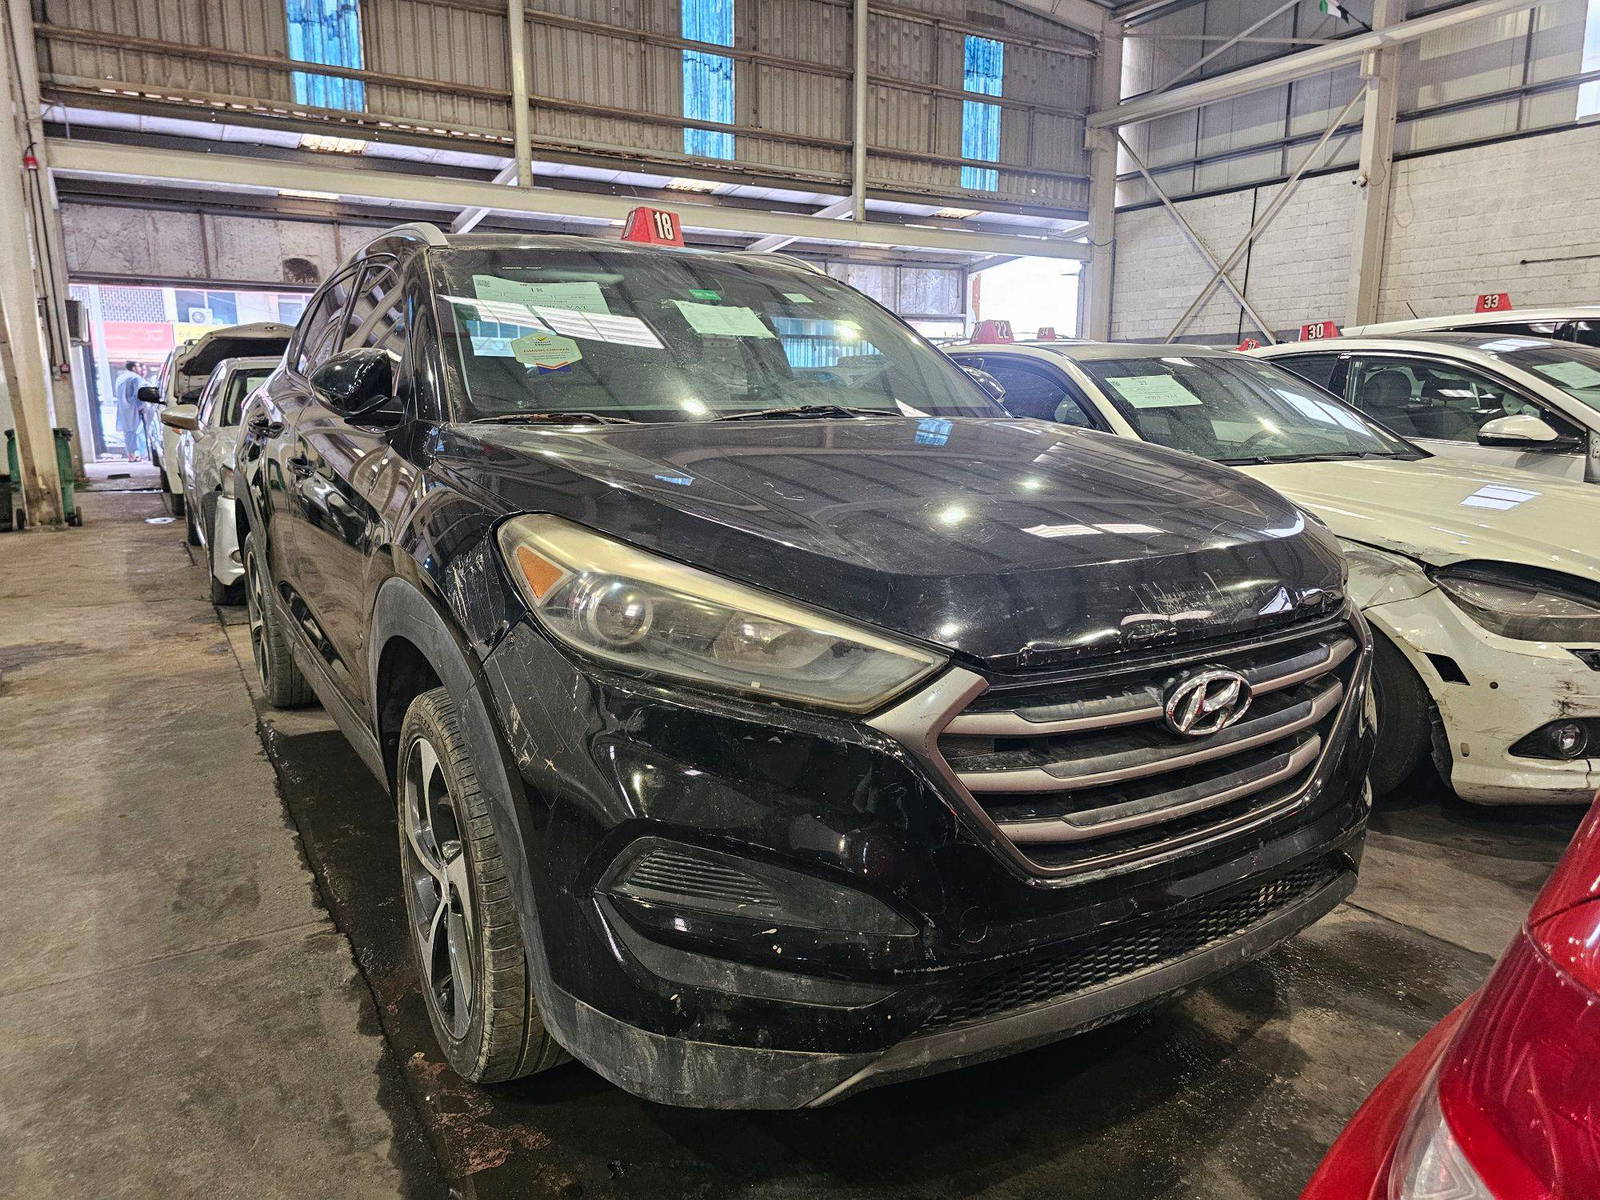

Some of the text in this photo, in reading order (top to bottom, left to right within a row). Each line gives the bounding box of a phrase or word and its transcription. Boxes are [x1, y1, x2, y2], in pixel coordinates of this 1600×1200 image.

[654, 211, 674, 240] 18
[1484, 294, 1500, 309] 33
[995, 321, 1010, 339] 22
[1308, 323, 1324, 339] 30
